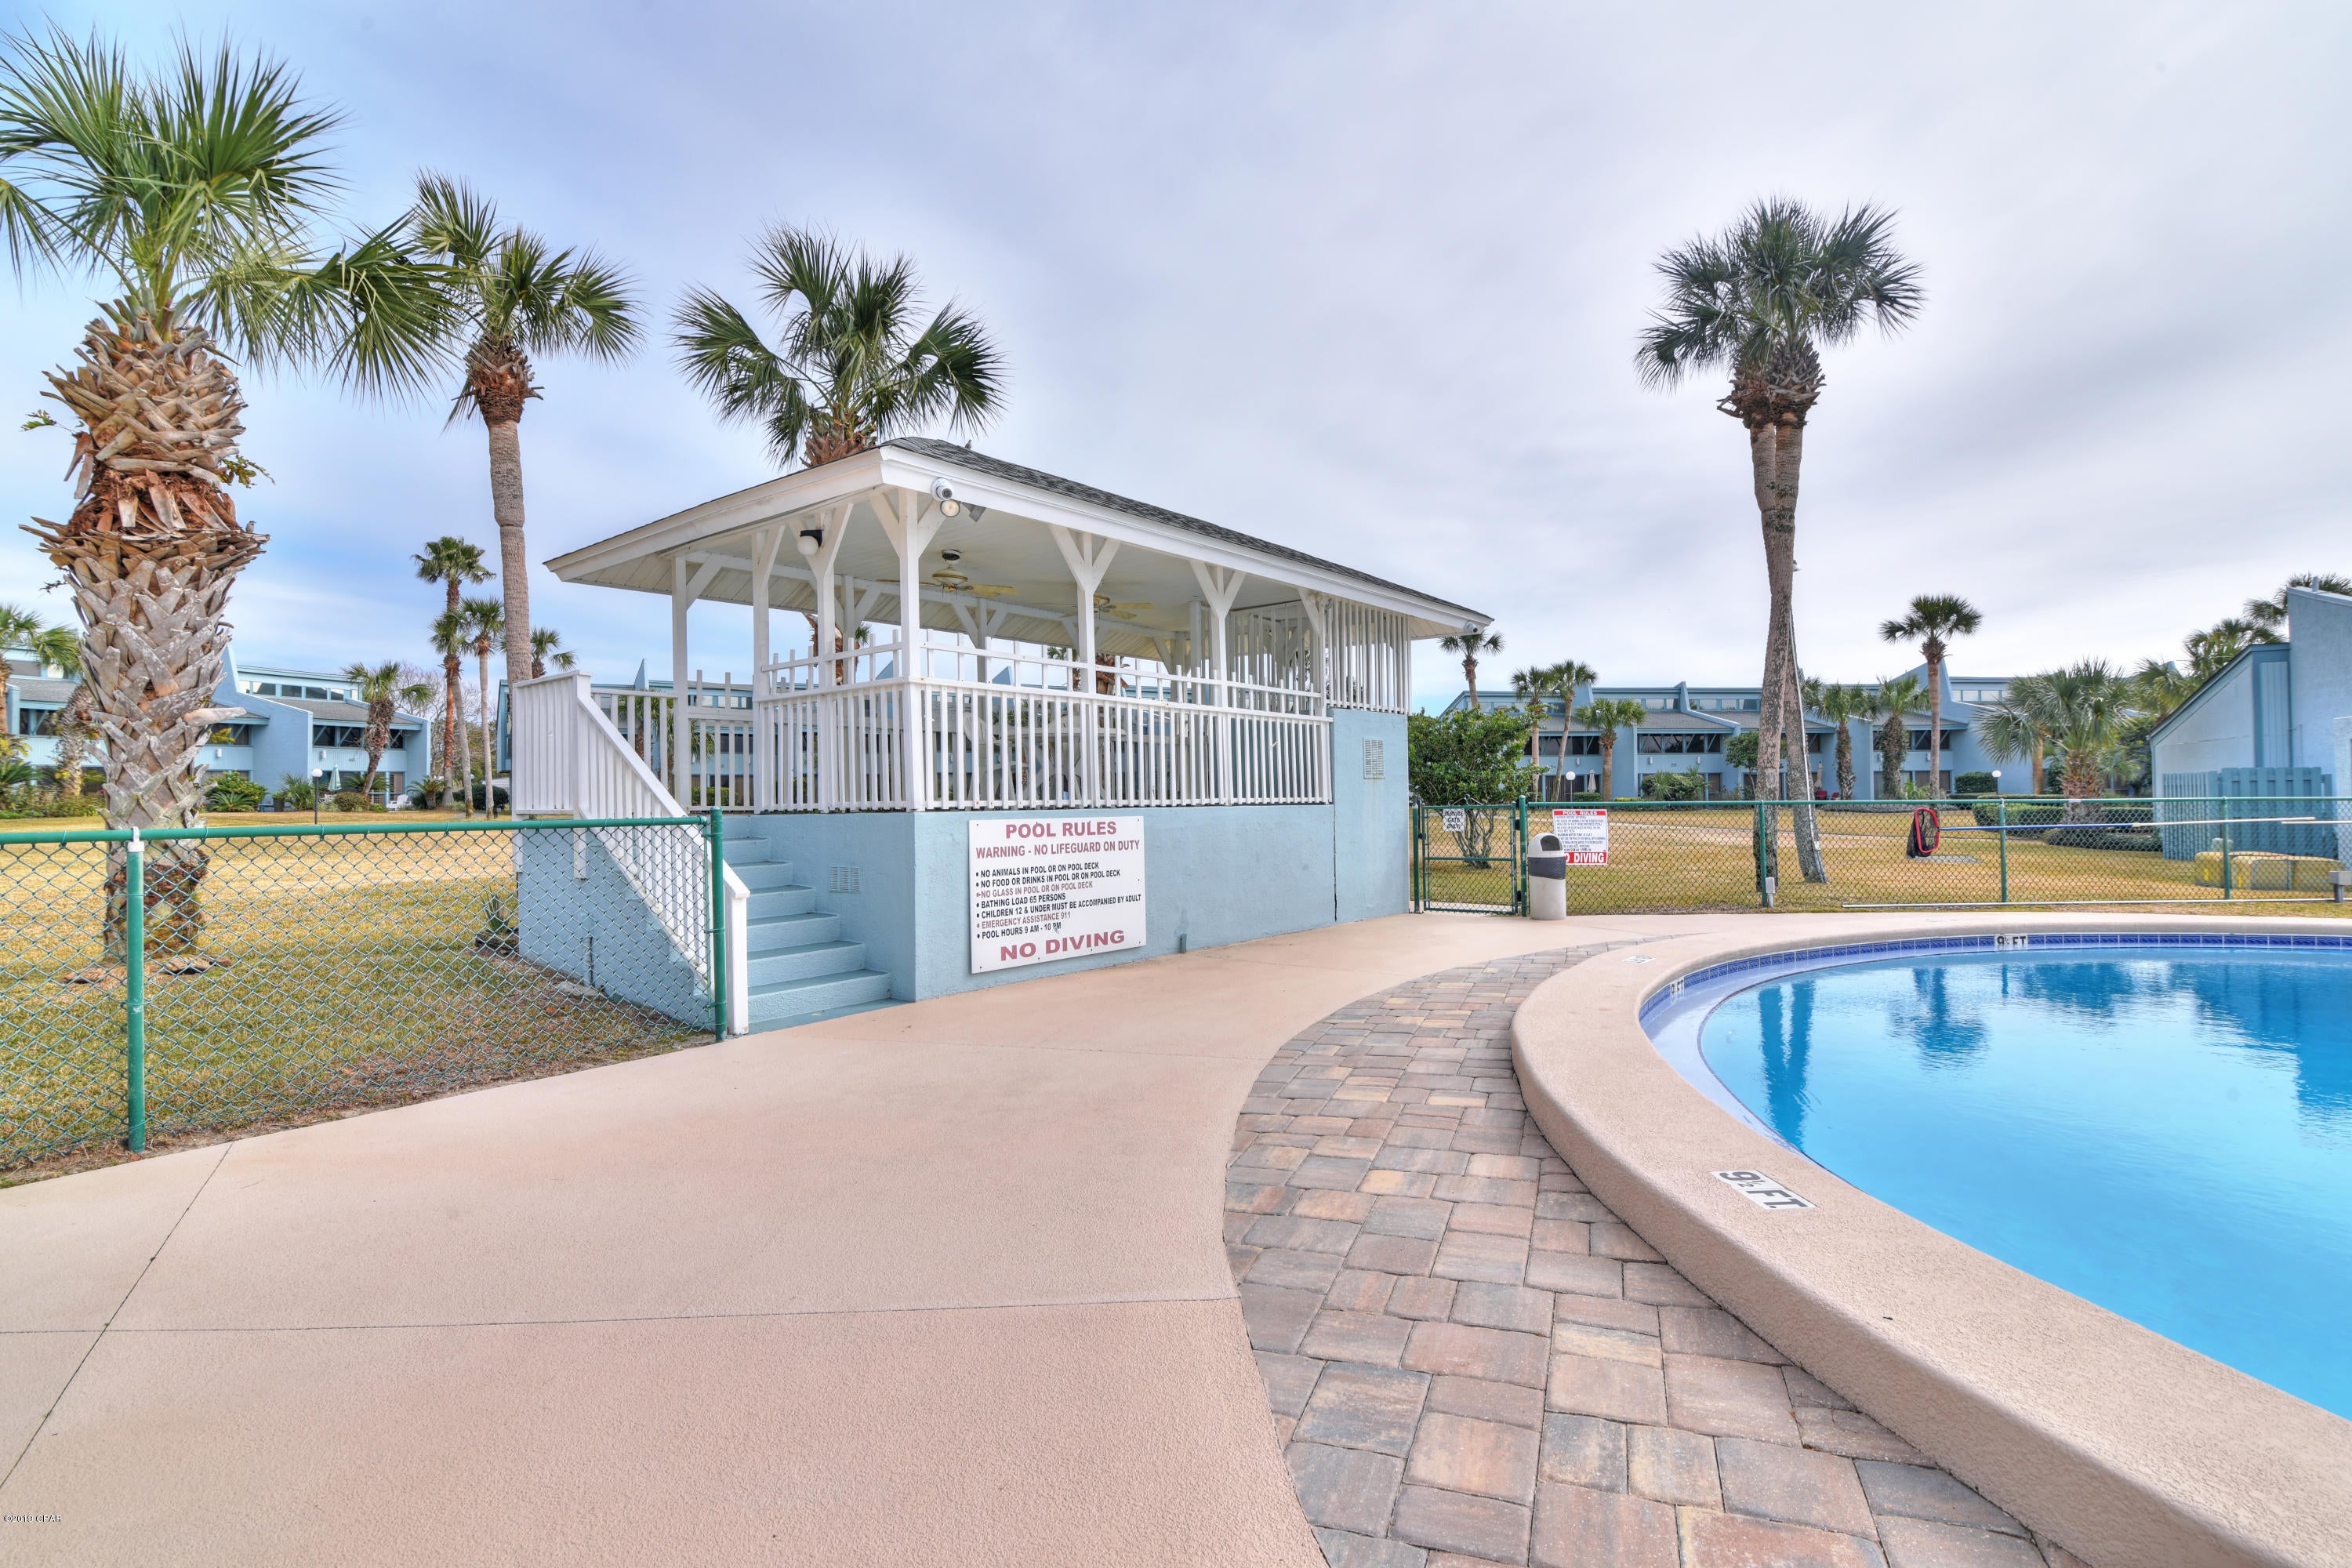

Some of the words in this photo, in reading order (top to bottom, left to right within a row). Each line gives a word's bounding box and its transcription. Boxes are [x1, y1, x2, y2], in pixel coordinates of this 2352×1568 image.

[1006, 823, 1056, 839] POOL
[1062, 822, 1116, 837] RULES
[976, 845, 1025, 858] WARNING
[1034, 844, 1047, 855] NO
[1051, 841, 1101, 855] LIFEGUARD
[1104, 841, 1115, 851] ON
[1118, 840, 1140, 851] DUTY
[1574, 853, 1604, 862] DIVING
[993, 868, 1020, 877] ANIMALS
[1031, 866, 1046, 874] POOL
[993, 878, 1010, 887] FOOD
[1022, 876, 1045, 884] DRINKS
[993, 888, 1013, 897] GLASS
[1024, 886, 1039, 895] POOL
[982, 898, 1010, 908] BATHING
[1039, 893, 1065, 902] PERSONS
[982, 909, 1013, 918] CHILDREN
[1030, 904, 1051, 913] UNDER
[1078, 897, 1116, 907] ACCOMPANIED
[982, 917, 1021, 929] EMERGENCY
[1022, 913, 1059, 924] ASSISTANCE
[1061, 911, 1070, 920] 911
[982, 930, 999, 939] POOL
[1001, 927, 1022, 937] HOURS
[1000, 942, 1036, 961] NO
[1046, 930, 1124, 954] DIVING
[2013, 936, 2026, 945] FT
